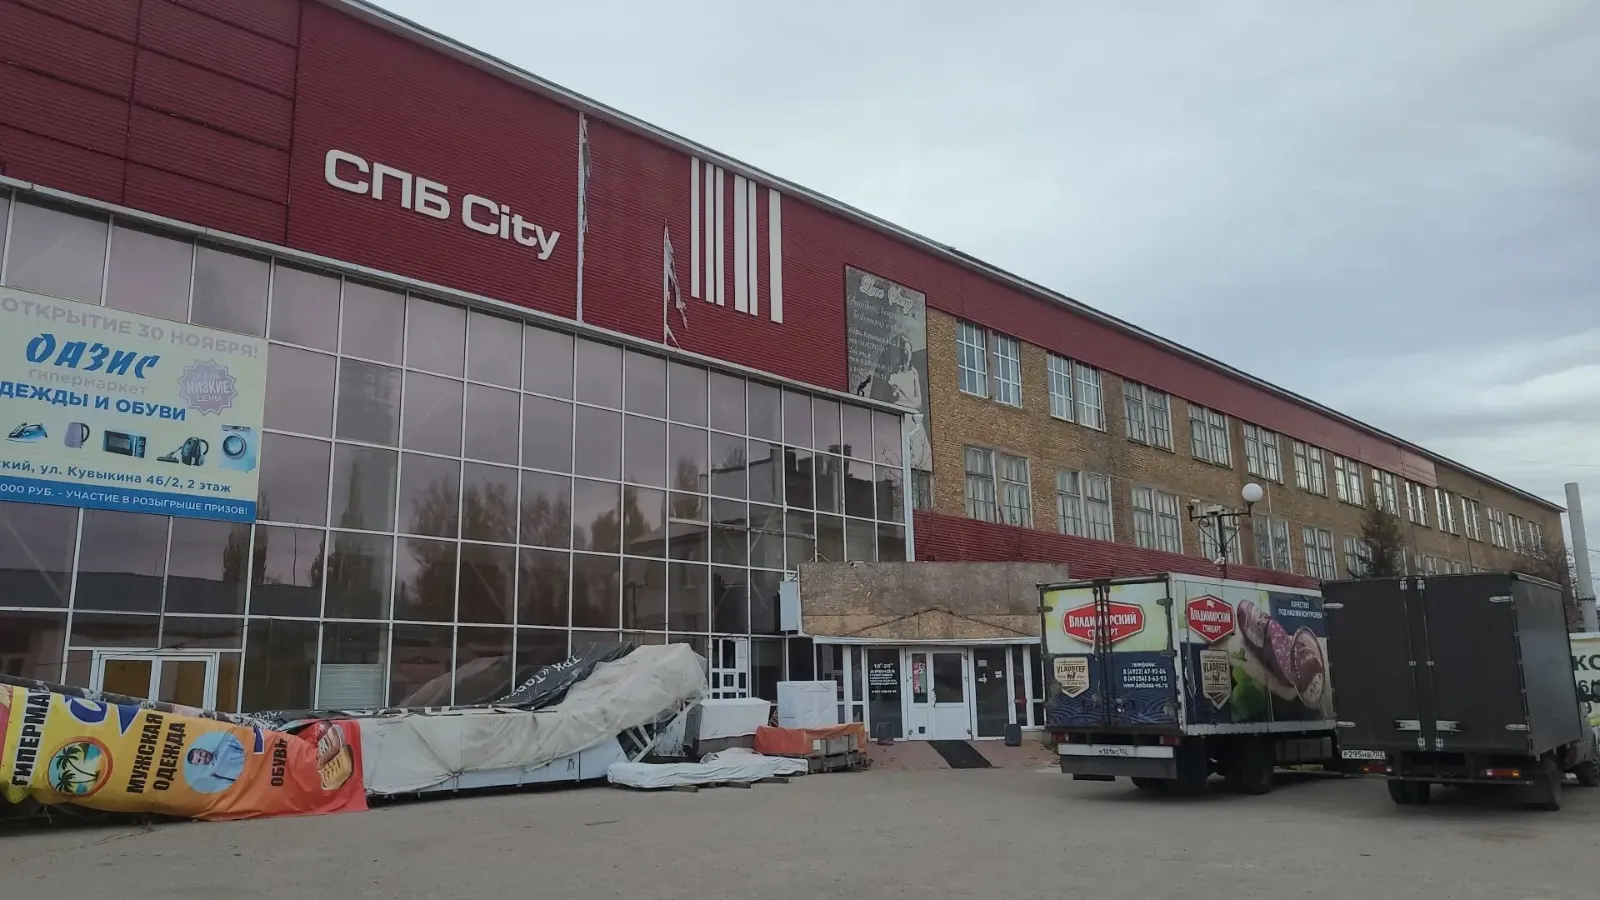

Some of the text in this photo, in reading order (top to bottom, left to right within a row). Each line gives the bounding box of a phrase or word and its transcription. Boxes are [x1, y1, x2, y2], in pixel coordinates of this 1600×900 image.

[324, 149, 561, 260] СПБ City
[1, 297, 259, 359] ОТКРЫТИЕ 30 НОЯБРЯ!
[26, 333, 160, 379] ОАЗИС
[0, 381, 186, 422] ДЕЖДЫ И ОБУВИ
[29, 368, 148, 397] гипермаркет
[186, 380, 231, 394] НИЗКИЕ
[197, 394, 222, 402] ЦЕНЫ
[0, 460, 231, 493] кий, ул. Кувыкина 46/2, 2 этаж
[28, 486, 55, 497] РУБ.
[66, 490, 120, 503] УЧАСТИЕ
[122, 495, 130, 504] В
[132, 496, 202, 511] РОЗЫГРЫШЕ
[204, 503, 248, 515] ПРИЗОВ!
[1056, 665, 1086, 673] VLADBEEF
[126, 712, 164, 794] МУЖСКАЯ
[153, 722, 187, 792] ОДЕЖДА
[270, 737, 289, 788] ОБУВЬ
